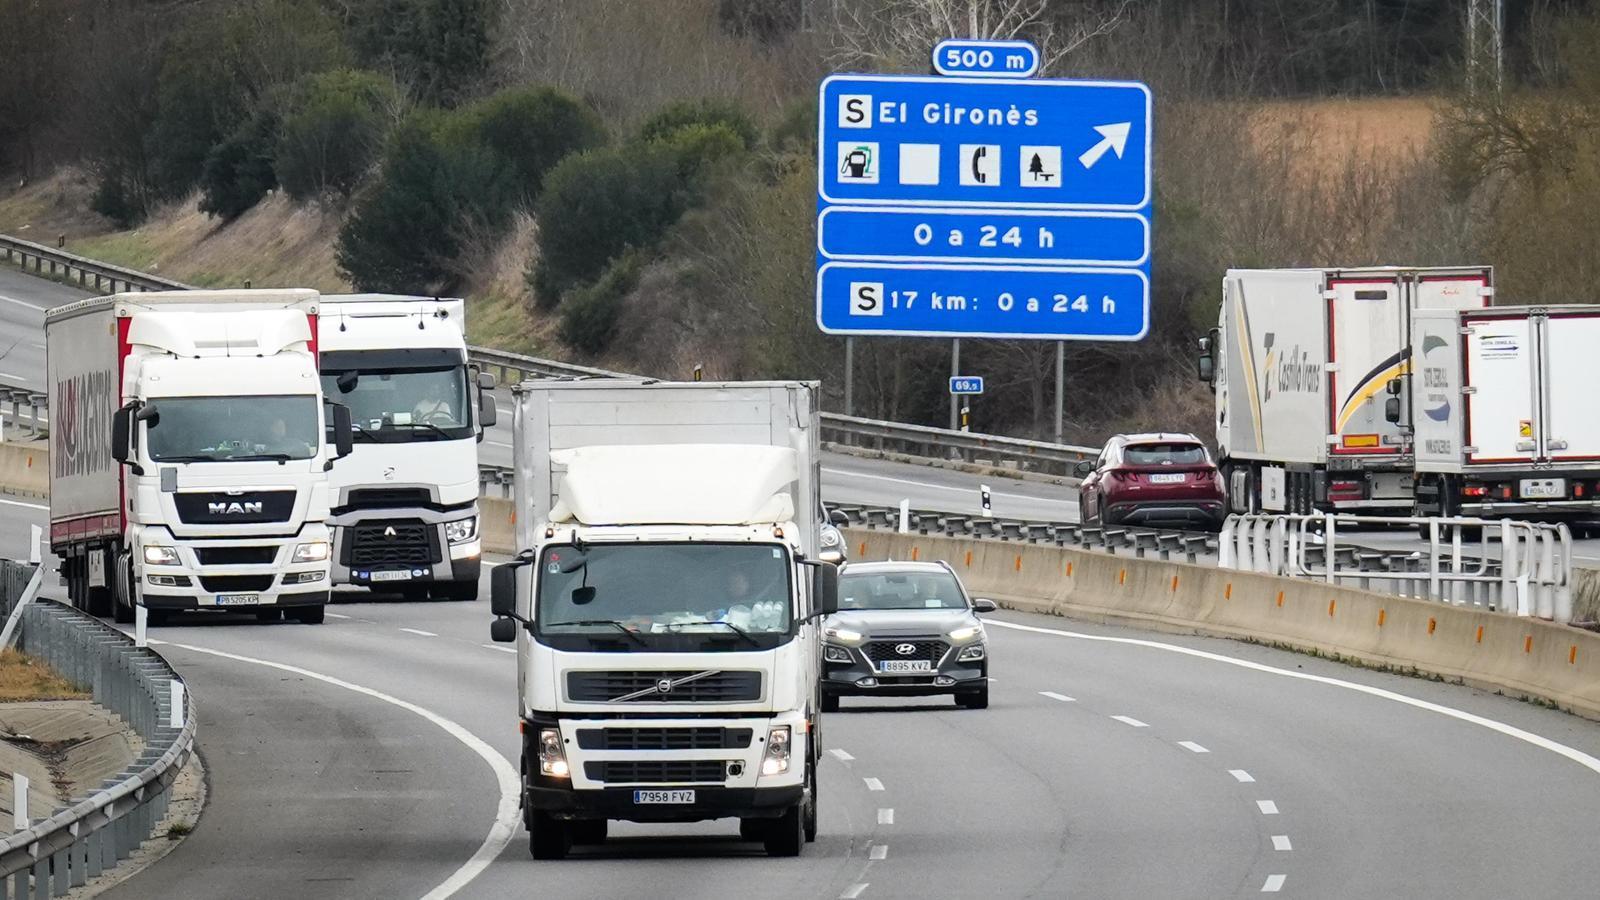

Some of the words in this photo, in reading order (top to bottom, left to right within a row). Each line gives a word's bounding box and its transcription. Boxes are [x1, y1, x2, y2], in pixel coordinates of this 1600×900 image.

[946, 50, 994, 68] 500
[1005, 54, 1025, 69] m
[845, 98, 865, 124] S
[879, 102, 907, 124] El
[922, 102, 1039, 127] Gironès
[913, 223, 932, 246] 0
[948, 230, 964, 247] a
[979, 226, 1022, 248] 24
[1039, 227, 1054, 249] h
[857, 286, 877, 311] S
[890, 291, 918, 310] 17
[931, 292, 979, 311] km:
[998, 292, 1011, 311] 0
[1026, 298, 1039, 312] a
[1052, 294, 1089, 313] 24
[1102, 295, 1116, 314] h
[208, 502, 262, 514] MAN
[886, 661, 909, 671] 8895
[911, 661, 929, 671] KVZ
[641, 792, 669, 802] 7958
[671, 792, 693, 802] FVZ
